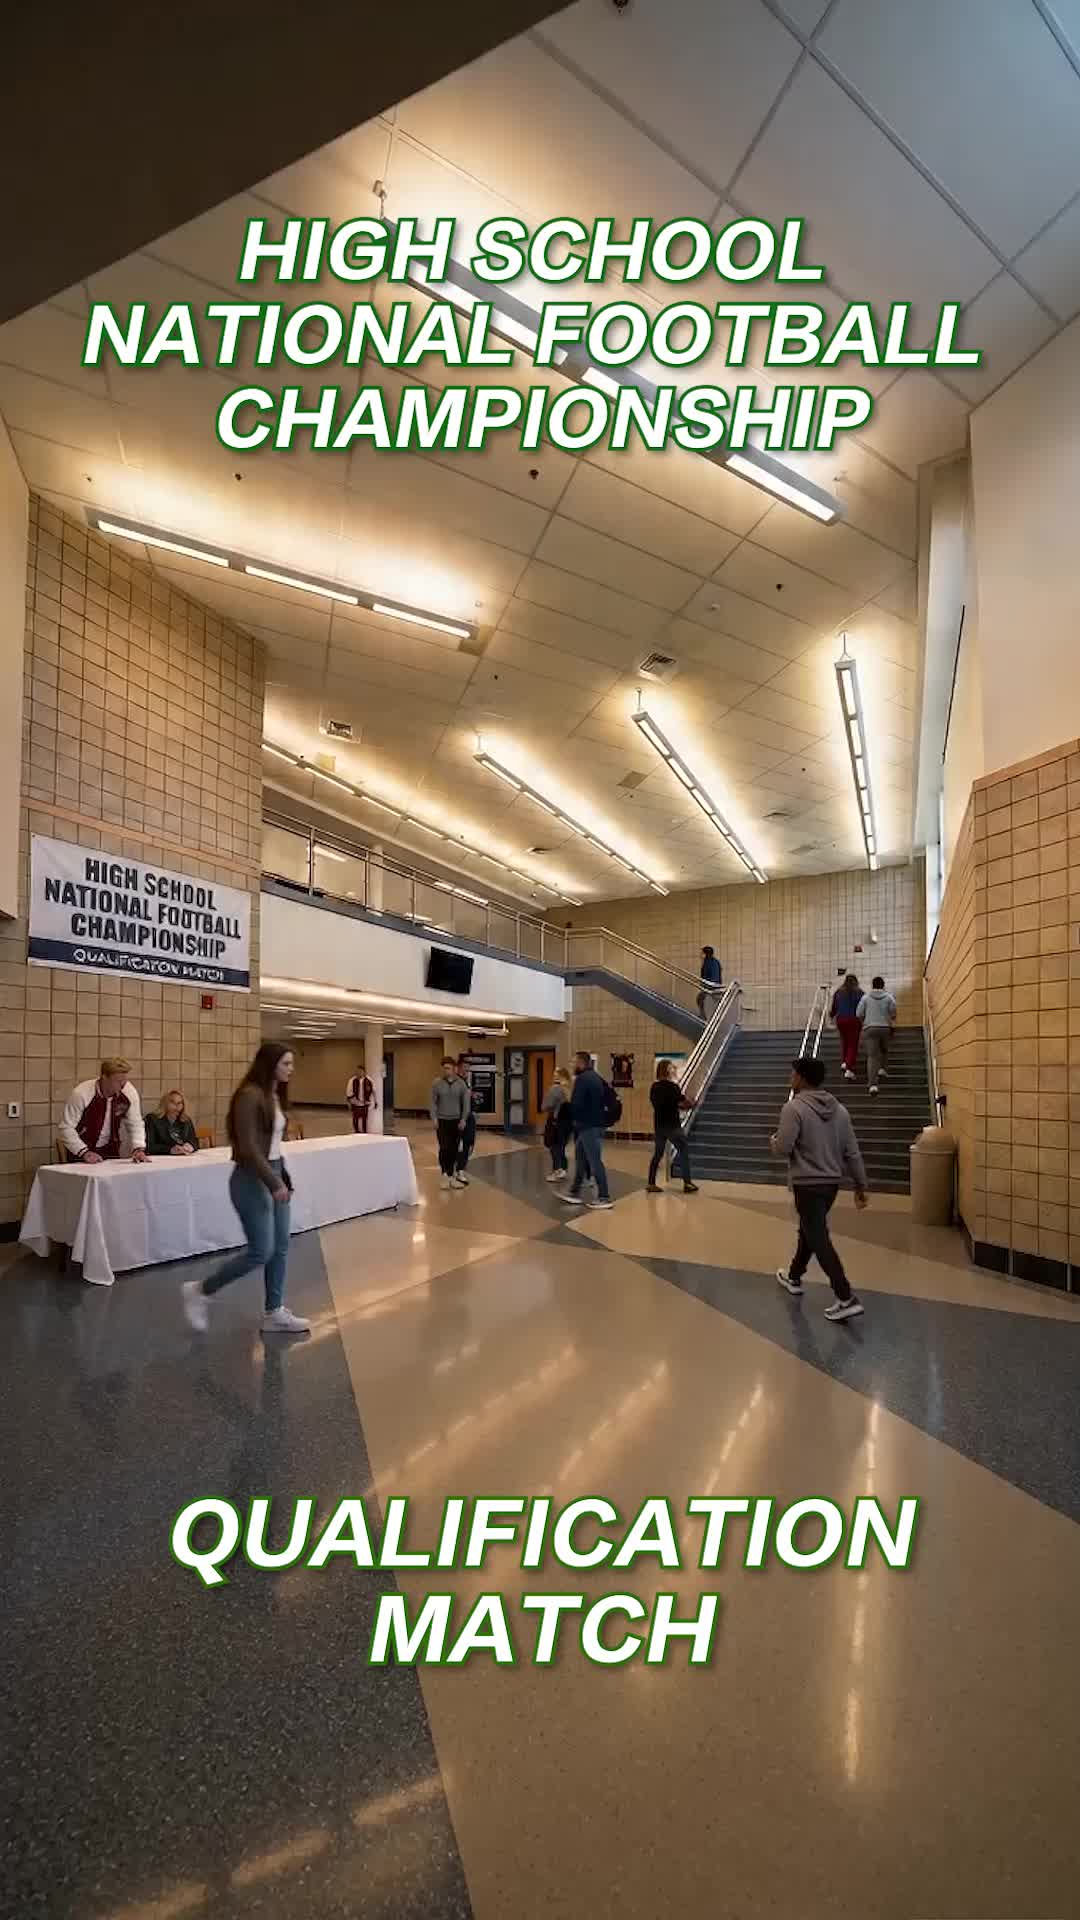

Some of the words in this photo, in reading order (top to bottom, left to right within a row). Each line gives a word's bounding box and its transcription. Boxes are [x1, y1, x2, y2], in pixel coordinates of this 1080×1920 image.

[45, 877, 152, 921] NATIONAL
[158, 903, 241, 939] FOOTBALL
[85, 857, 138, 891] HIGH
[144, 873, 217, 911] SCHOOL
[71, 913, 226, 960] CHAMPIONSHIP
